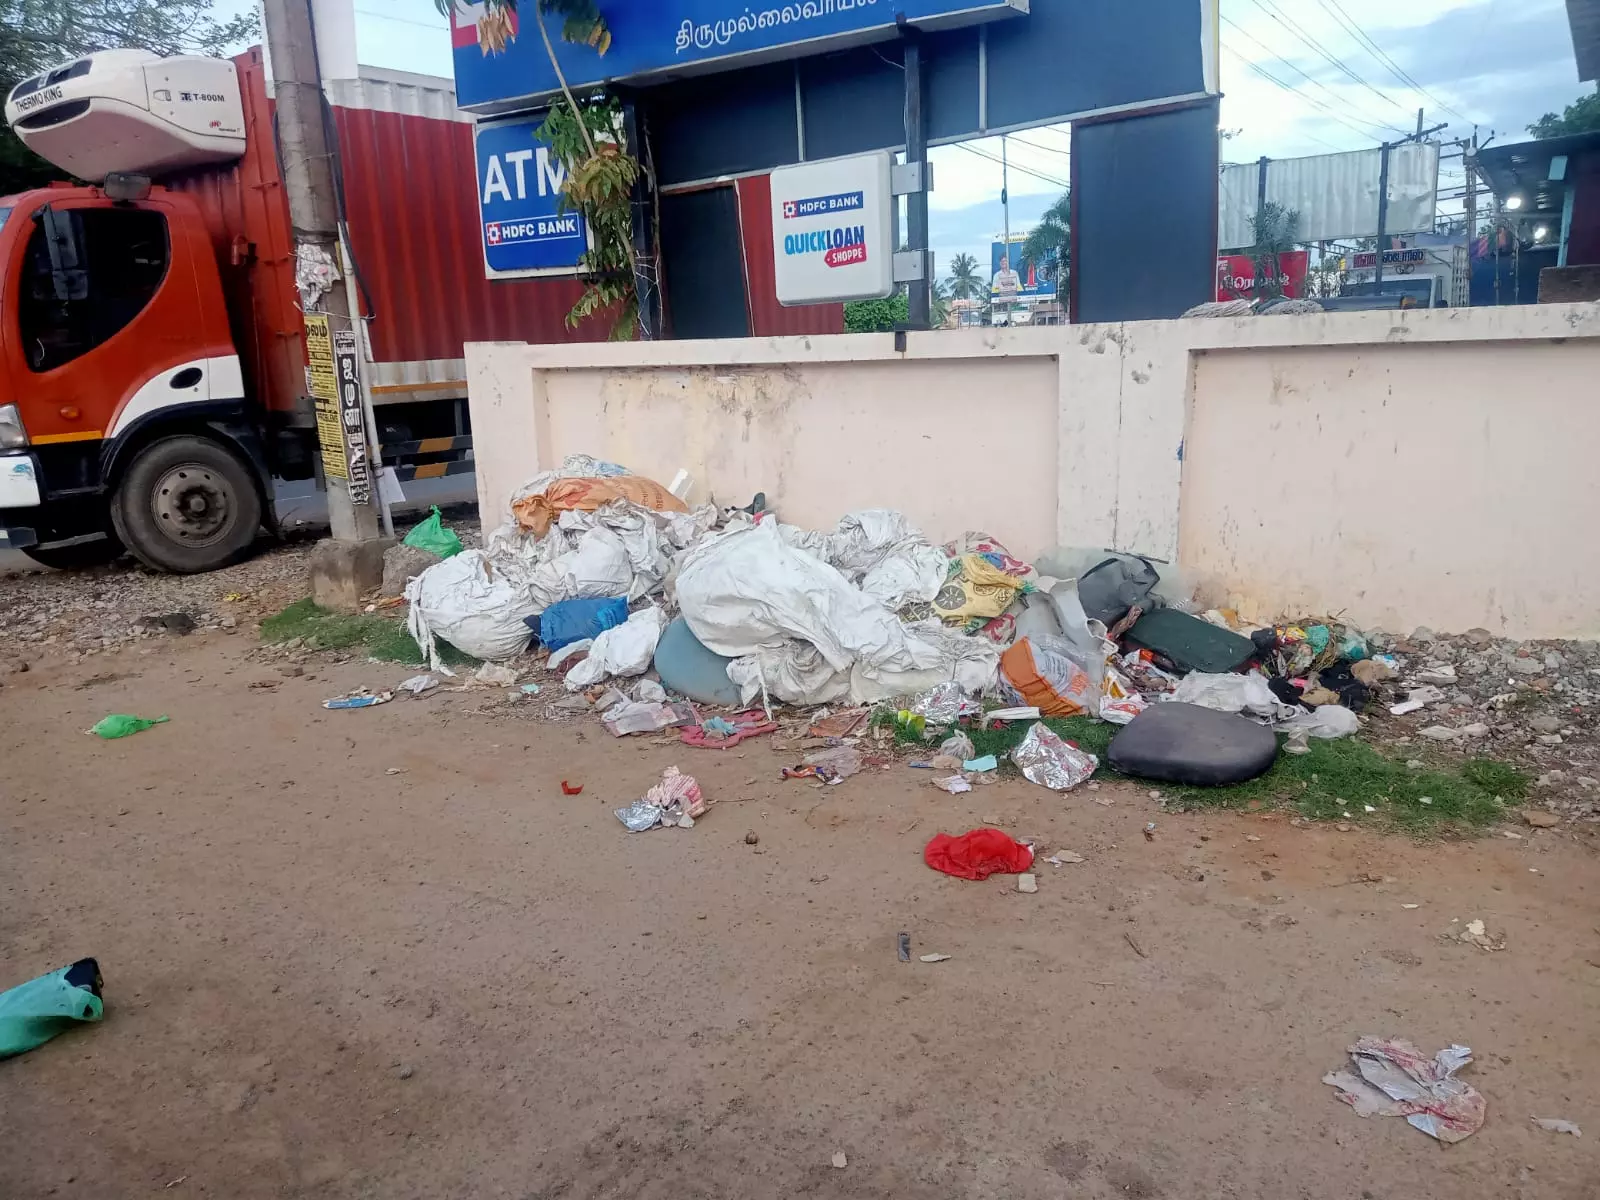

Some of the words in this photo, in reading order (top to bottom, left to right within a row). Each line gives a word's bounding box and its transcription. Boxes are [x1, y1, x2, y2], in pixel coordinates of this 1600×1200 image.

[15, 92, 44, 112] THERMO
[43, 86, 63, 103] KING
[483, 147, 575, 204] ATM
[799, 201, 827, 213] HDFC
[829, 196, 859, 209] BANK
[502, 223, 535, 239] HDFC
[538, 219, 576, 235] BANK
[832, 247, 863, 264] SHOPPE
